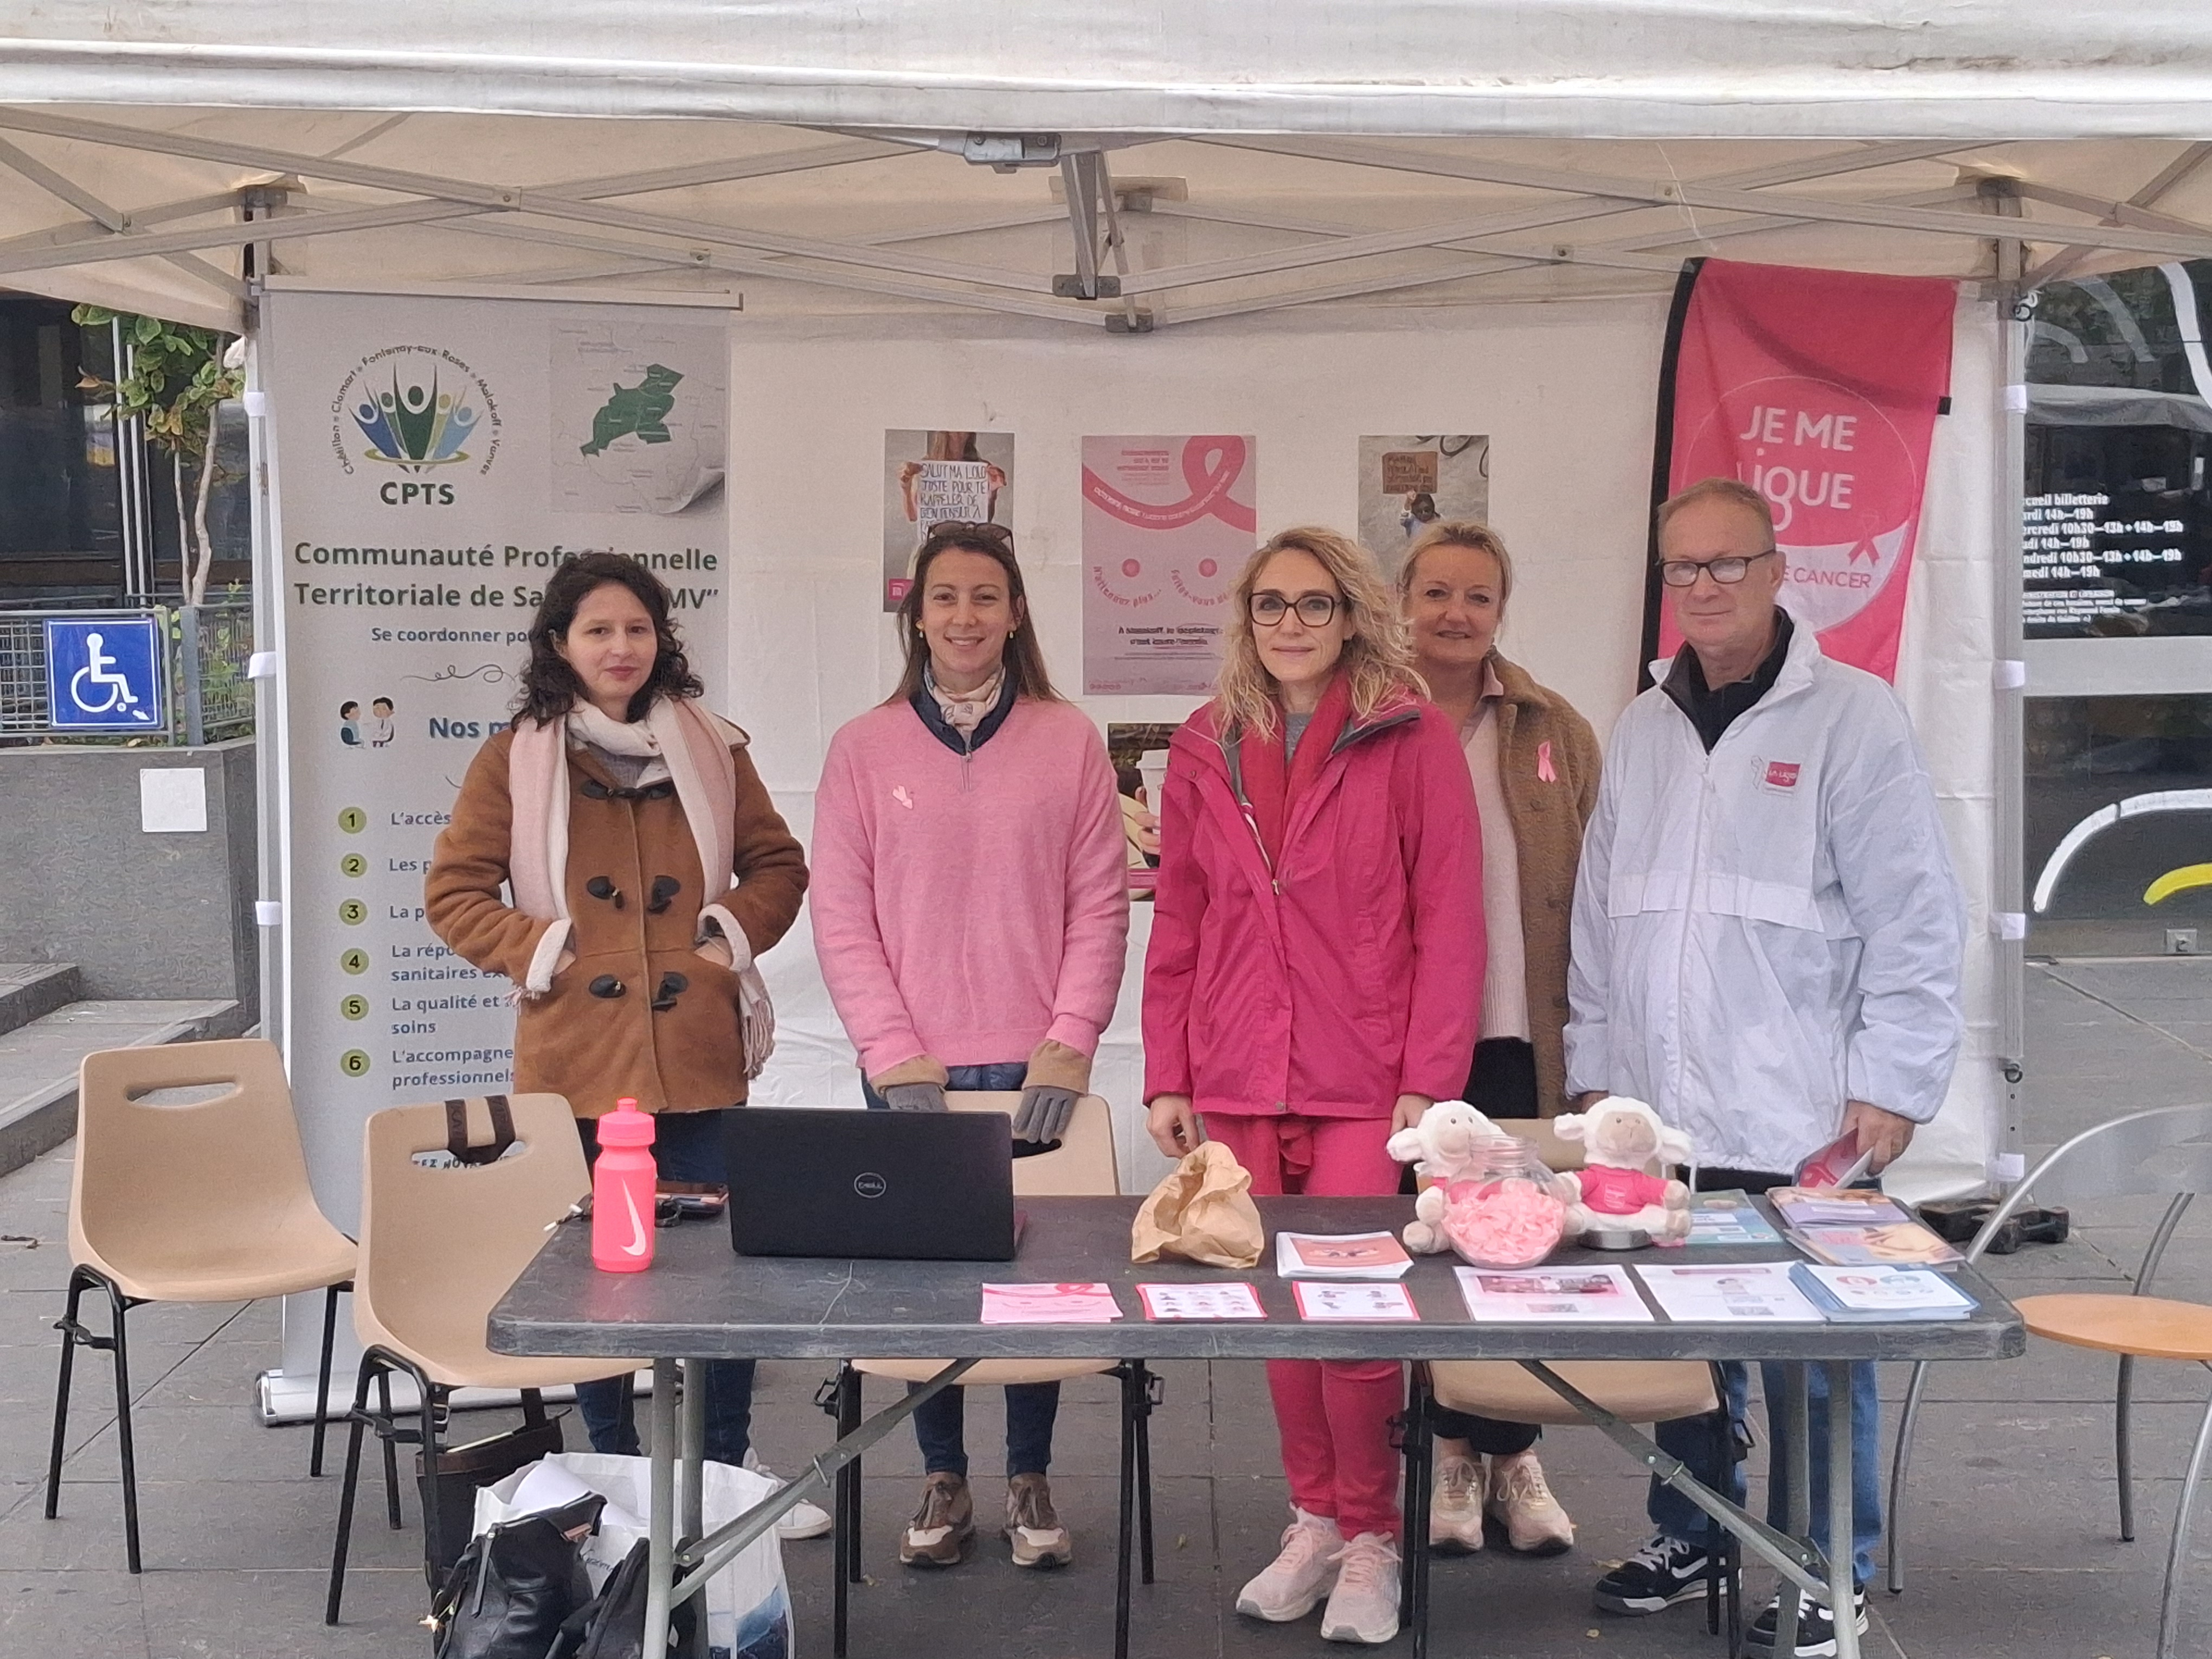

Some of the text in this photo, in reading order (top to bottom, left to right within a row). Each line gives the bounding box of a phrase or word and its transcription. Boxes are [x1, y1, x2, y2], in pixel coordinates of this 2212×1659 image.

[1739, 406, 1857, 452] JE ME
[949, 465, 962, 479] MA
[380, 481, 454, 505] CPTS
[953, 480, 974, 493] POUR
[976, 481, 986, 494] TE
[2054, 493, 2110, 505] billetterie
[2023, 523, 2059, 536] ercredi
[294, 543, 494, 567] Communauté
[2023, 552, 2058, 564] ndredi
[1793, 567, 1872, 589] CANCER
[2023, 566, 2049, 578] medi
[294, 582, 461, 606] Territoriale
[471, 584, 505, 607] de
[513, 586, 544, 607] Sa
[372, 628, 528, 646] Se coordonner po
[429, 717, 479, 739] Nos
[348, 813, 355, 827] 1
[391, 811, 451, 825] L'accès
[349, 859, 359, 872] 2
[390, 858, 417, 872] Les
[348, 904, 359, 919] 3
[390, 905, 409, 919] La
[392, 942, 455, 961] La répo
[349, 954, 360, 968] 4
[391, 966, 477, 981] sanitaires
[349, 1000, 361, 1015] 5
[392, 994, 500, 1014] La qualité et
[391, 1020, 436, 1034] soins
[349, 1056, 361, 1071] 6
[393, 1048, 514, 1065] L'accompagne
